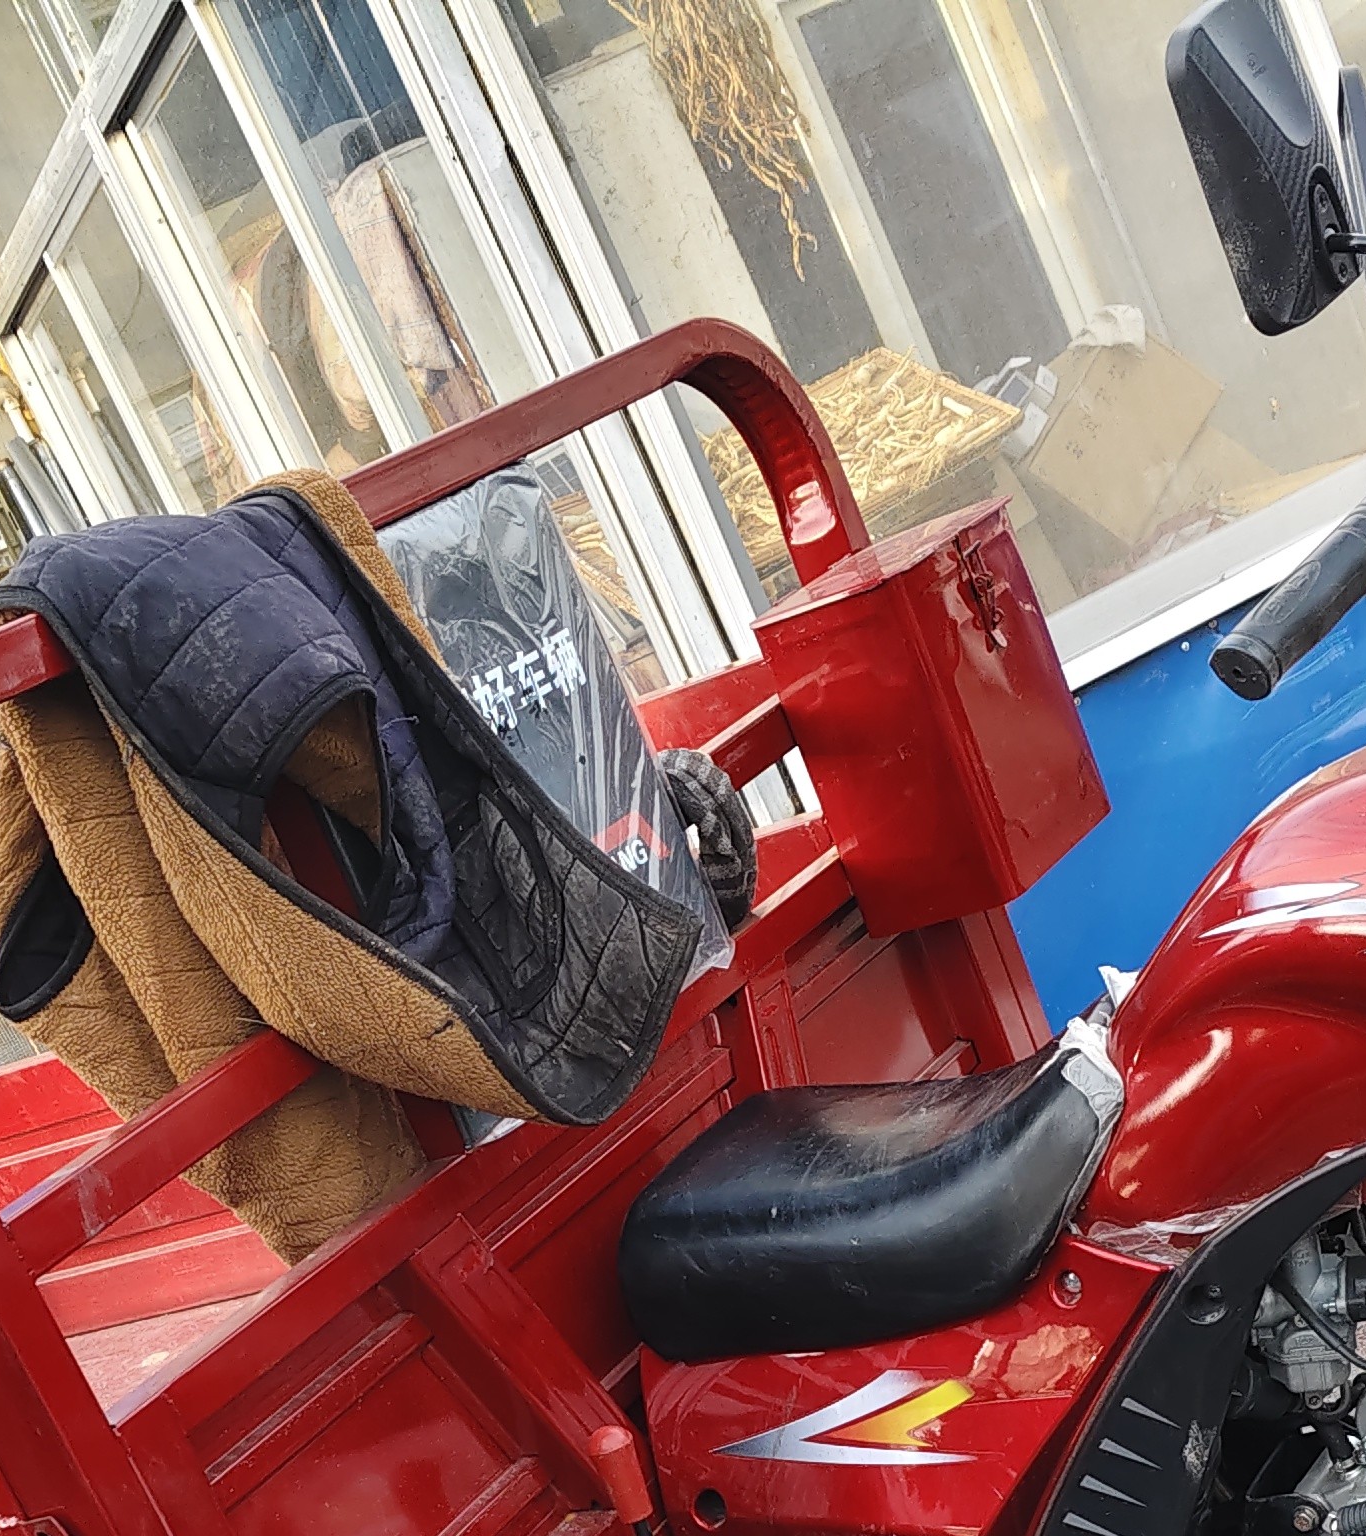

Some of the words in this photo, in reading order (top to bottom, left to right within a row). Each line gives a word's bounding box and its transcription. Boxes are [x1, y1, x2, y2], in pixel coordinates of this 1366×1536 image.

[461, 628, 587, 735] 好车辆
[611, 839, 648, 873] NG
